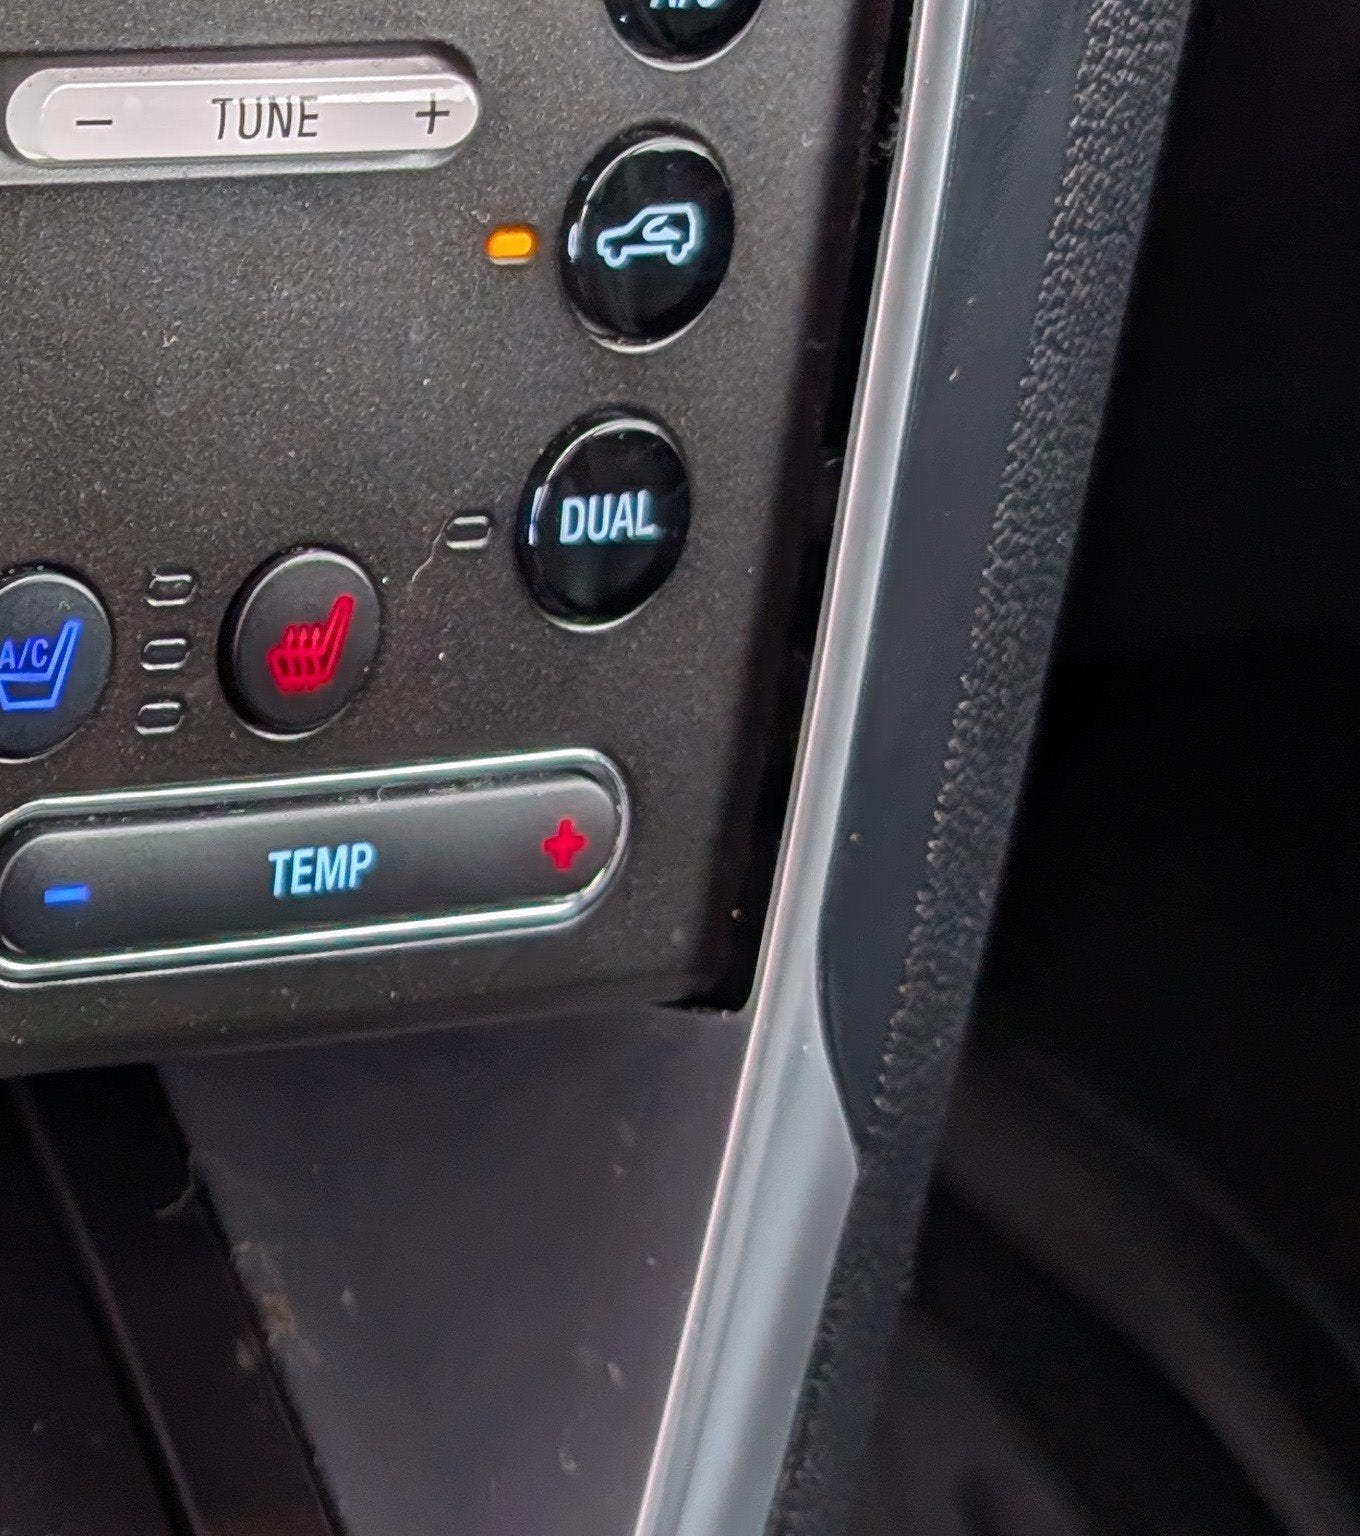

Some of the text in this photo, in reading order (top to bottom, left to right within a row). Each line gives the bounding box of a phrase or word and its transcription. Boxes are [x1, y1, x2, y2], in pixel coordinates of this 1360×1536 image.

[211, 96, 319, 139] TUNE
[560, 490, 658, 544] DUAL
[268, 841, 377, 898] TEMP
